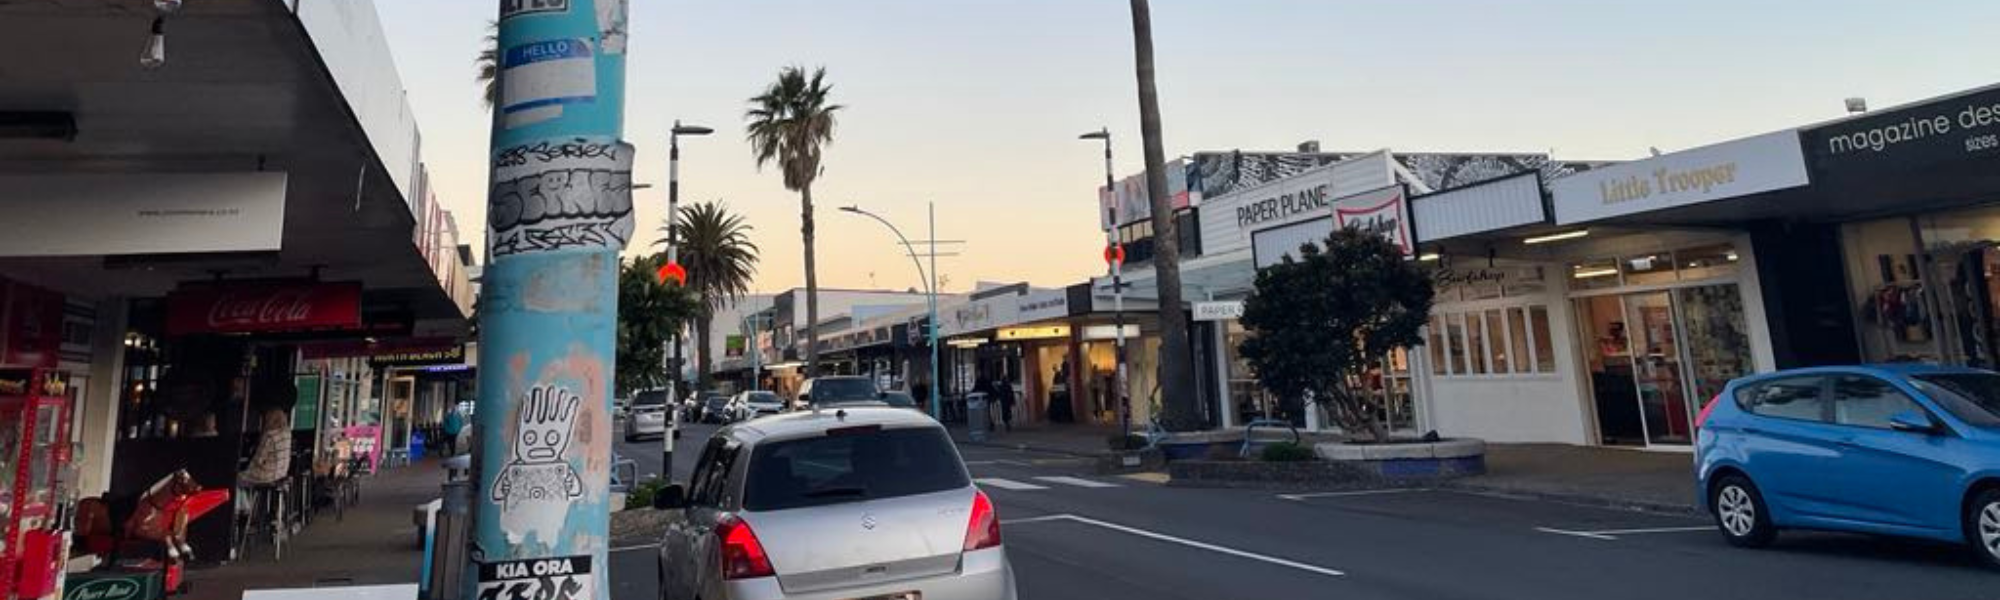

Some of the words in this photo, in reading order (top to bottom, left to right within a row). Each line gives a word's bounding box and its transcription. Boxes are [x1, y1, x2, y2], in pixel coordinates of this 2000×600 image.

[522, 40, 568, 57] HELLO
[1829, 115, 1950, 154] magazine
[1964, 134, 1998, 151] sizes
[1600, 176, 1650, 204] Little
[1654, 161, 1736, 194] Trooper
[1236, 198, 1279, 227] PAPER
[1281, 184, 1329, 218] PLANE
[1201, 304, 1236, 315] PAPER
[495, 562, 529, 579] KIA
[532, 558, 574, 576] ORA
